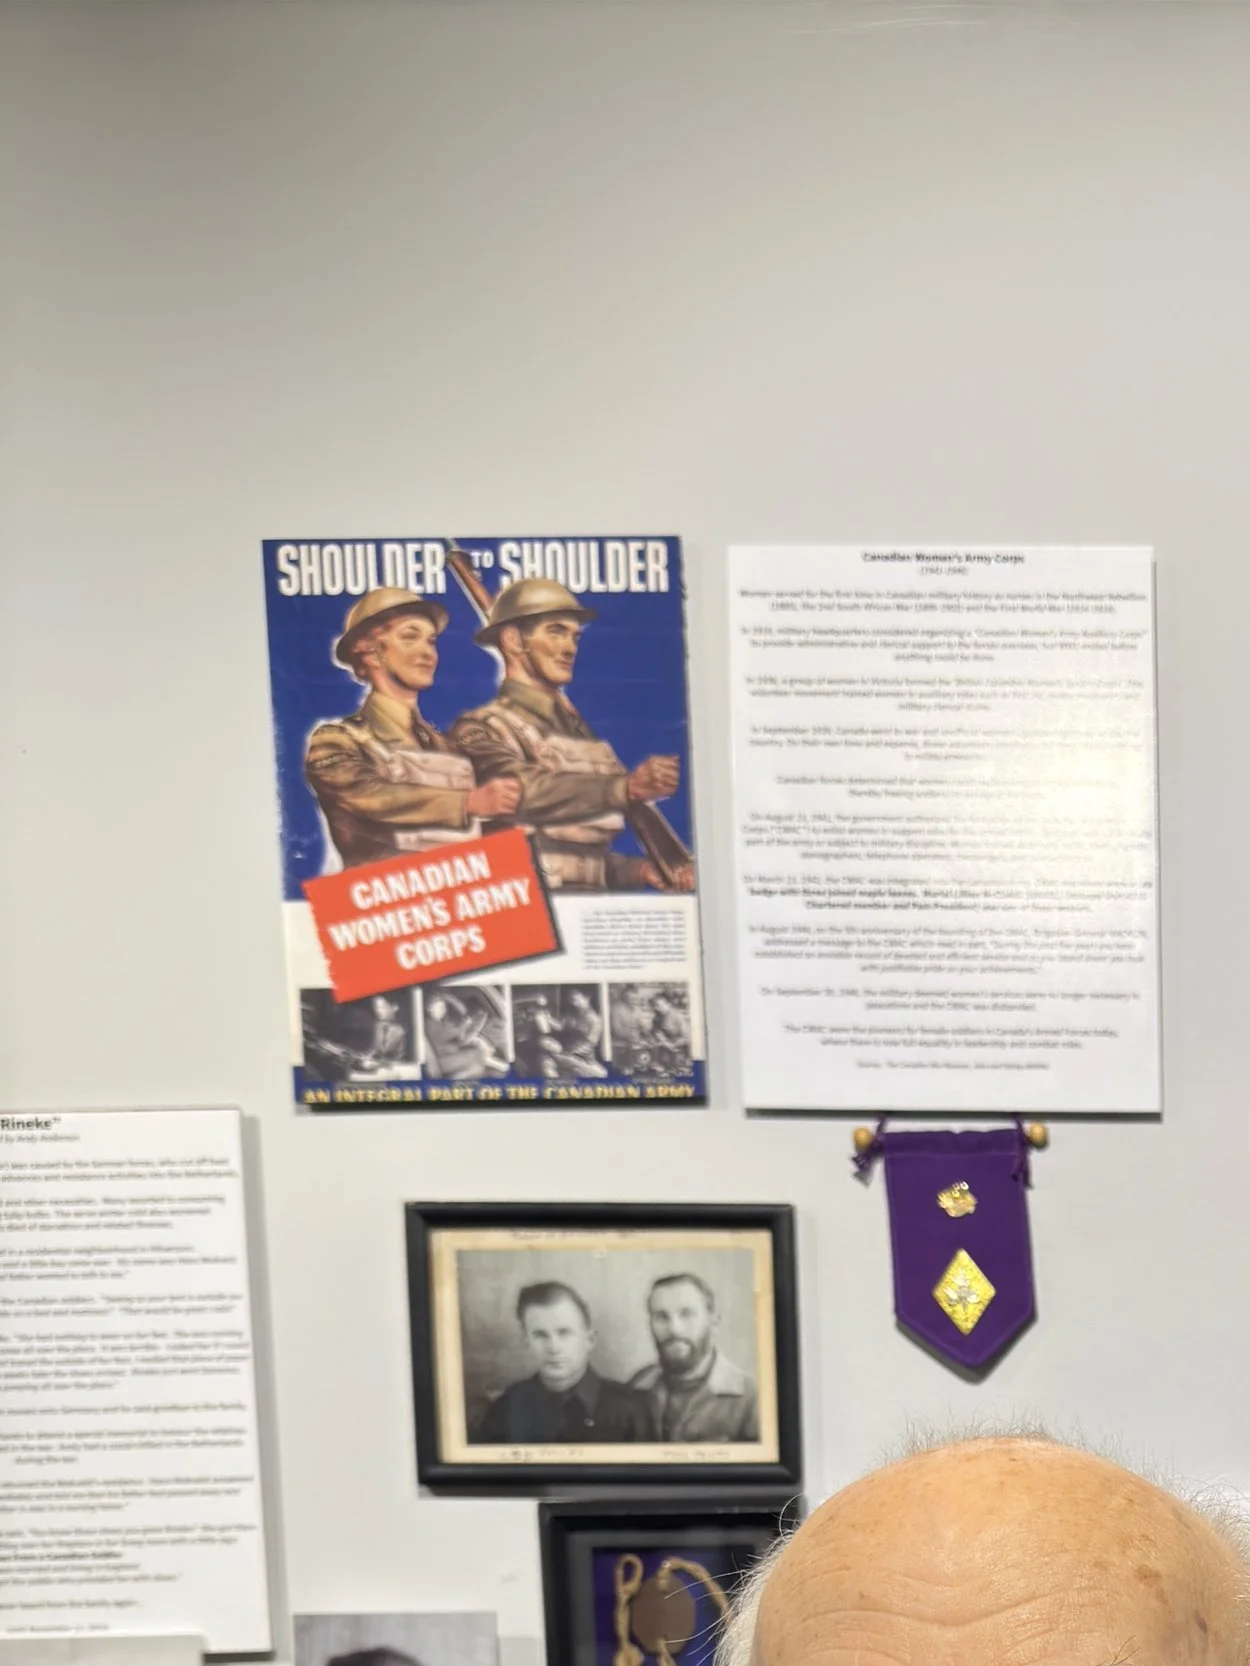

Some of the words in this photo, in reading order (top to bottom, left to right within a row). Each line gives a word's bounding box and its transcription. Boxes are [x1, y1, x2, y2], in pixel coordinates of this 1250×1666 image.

[277, 543, 447, 596] SHOULDER
[471, 551, 495, 568] TO
[499, 541, 669, 594] SHOULDER
[965, 554, 992, 562] Army
[351, 852, 492, 910] CANADIAN
[327, 895, 453, 953] WOMEN'S
[456, 877, 533, 921] ARMY
[396, 926, 487, 972] CORPS
